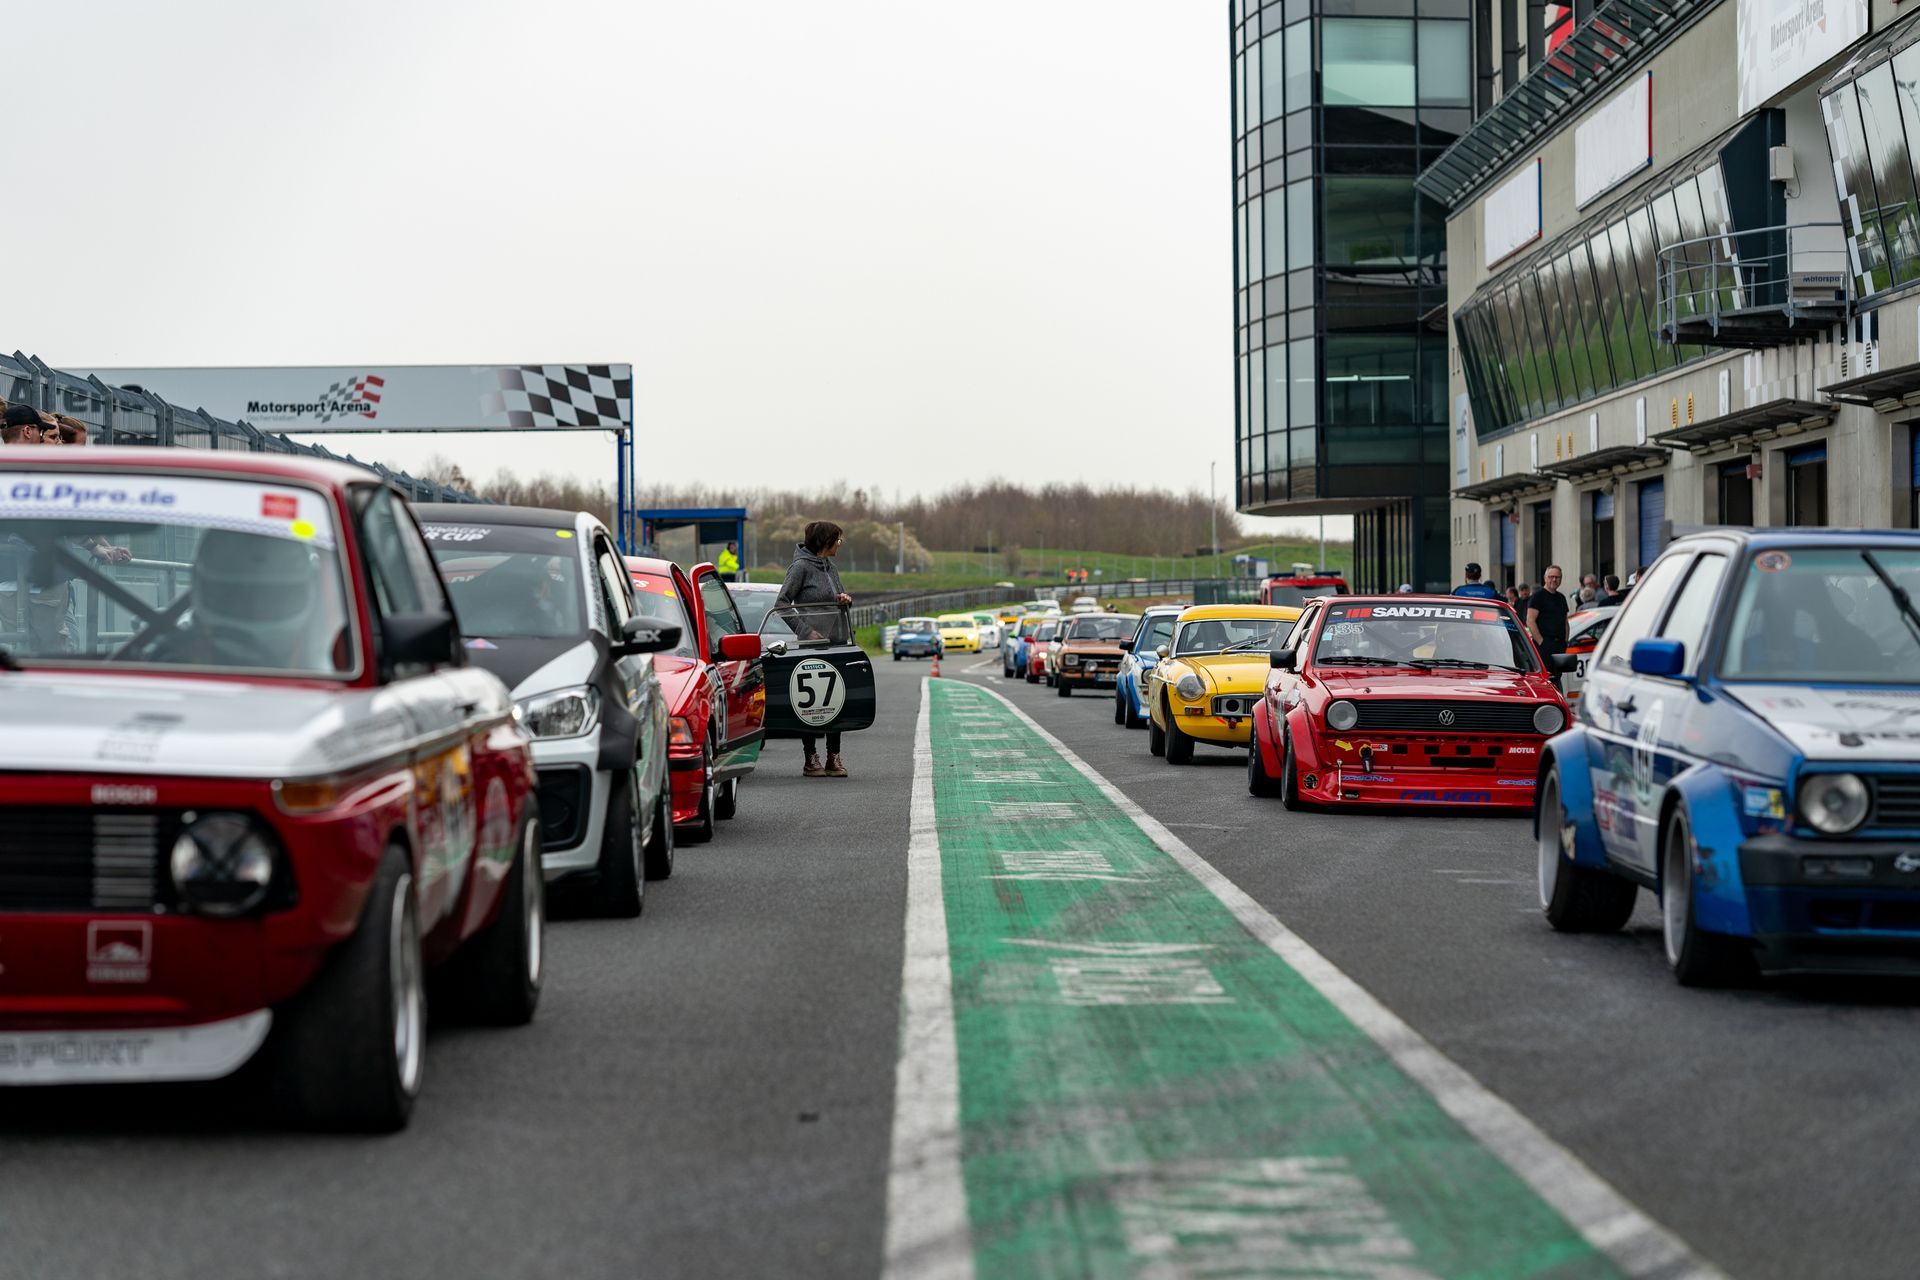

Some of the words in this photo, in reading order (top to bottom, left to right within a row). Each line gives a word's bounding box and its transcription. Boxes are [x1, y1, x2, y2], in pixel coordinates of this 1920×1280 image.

[247, 401, 326, 416] Motorsport
[330, 401, 371, 413] Arena
[441, 533, 485, 542] CUP
[1372, 606, 1472, 620] SANDTLER
[630, 629, 662, 643] SX
[797, 671, 836, 708] 57
[91, 784, 157, 804] BOSCH
[1400, 790, 1491, 803] FALKEN
